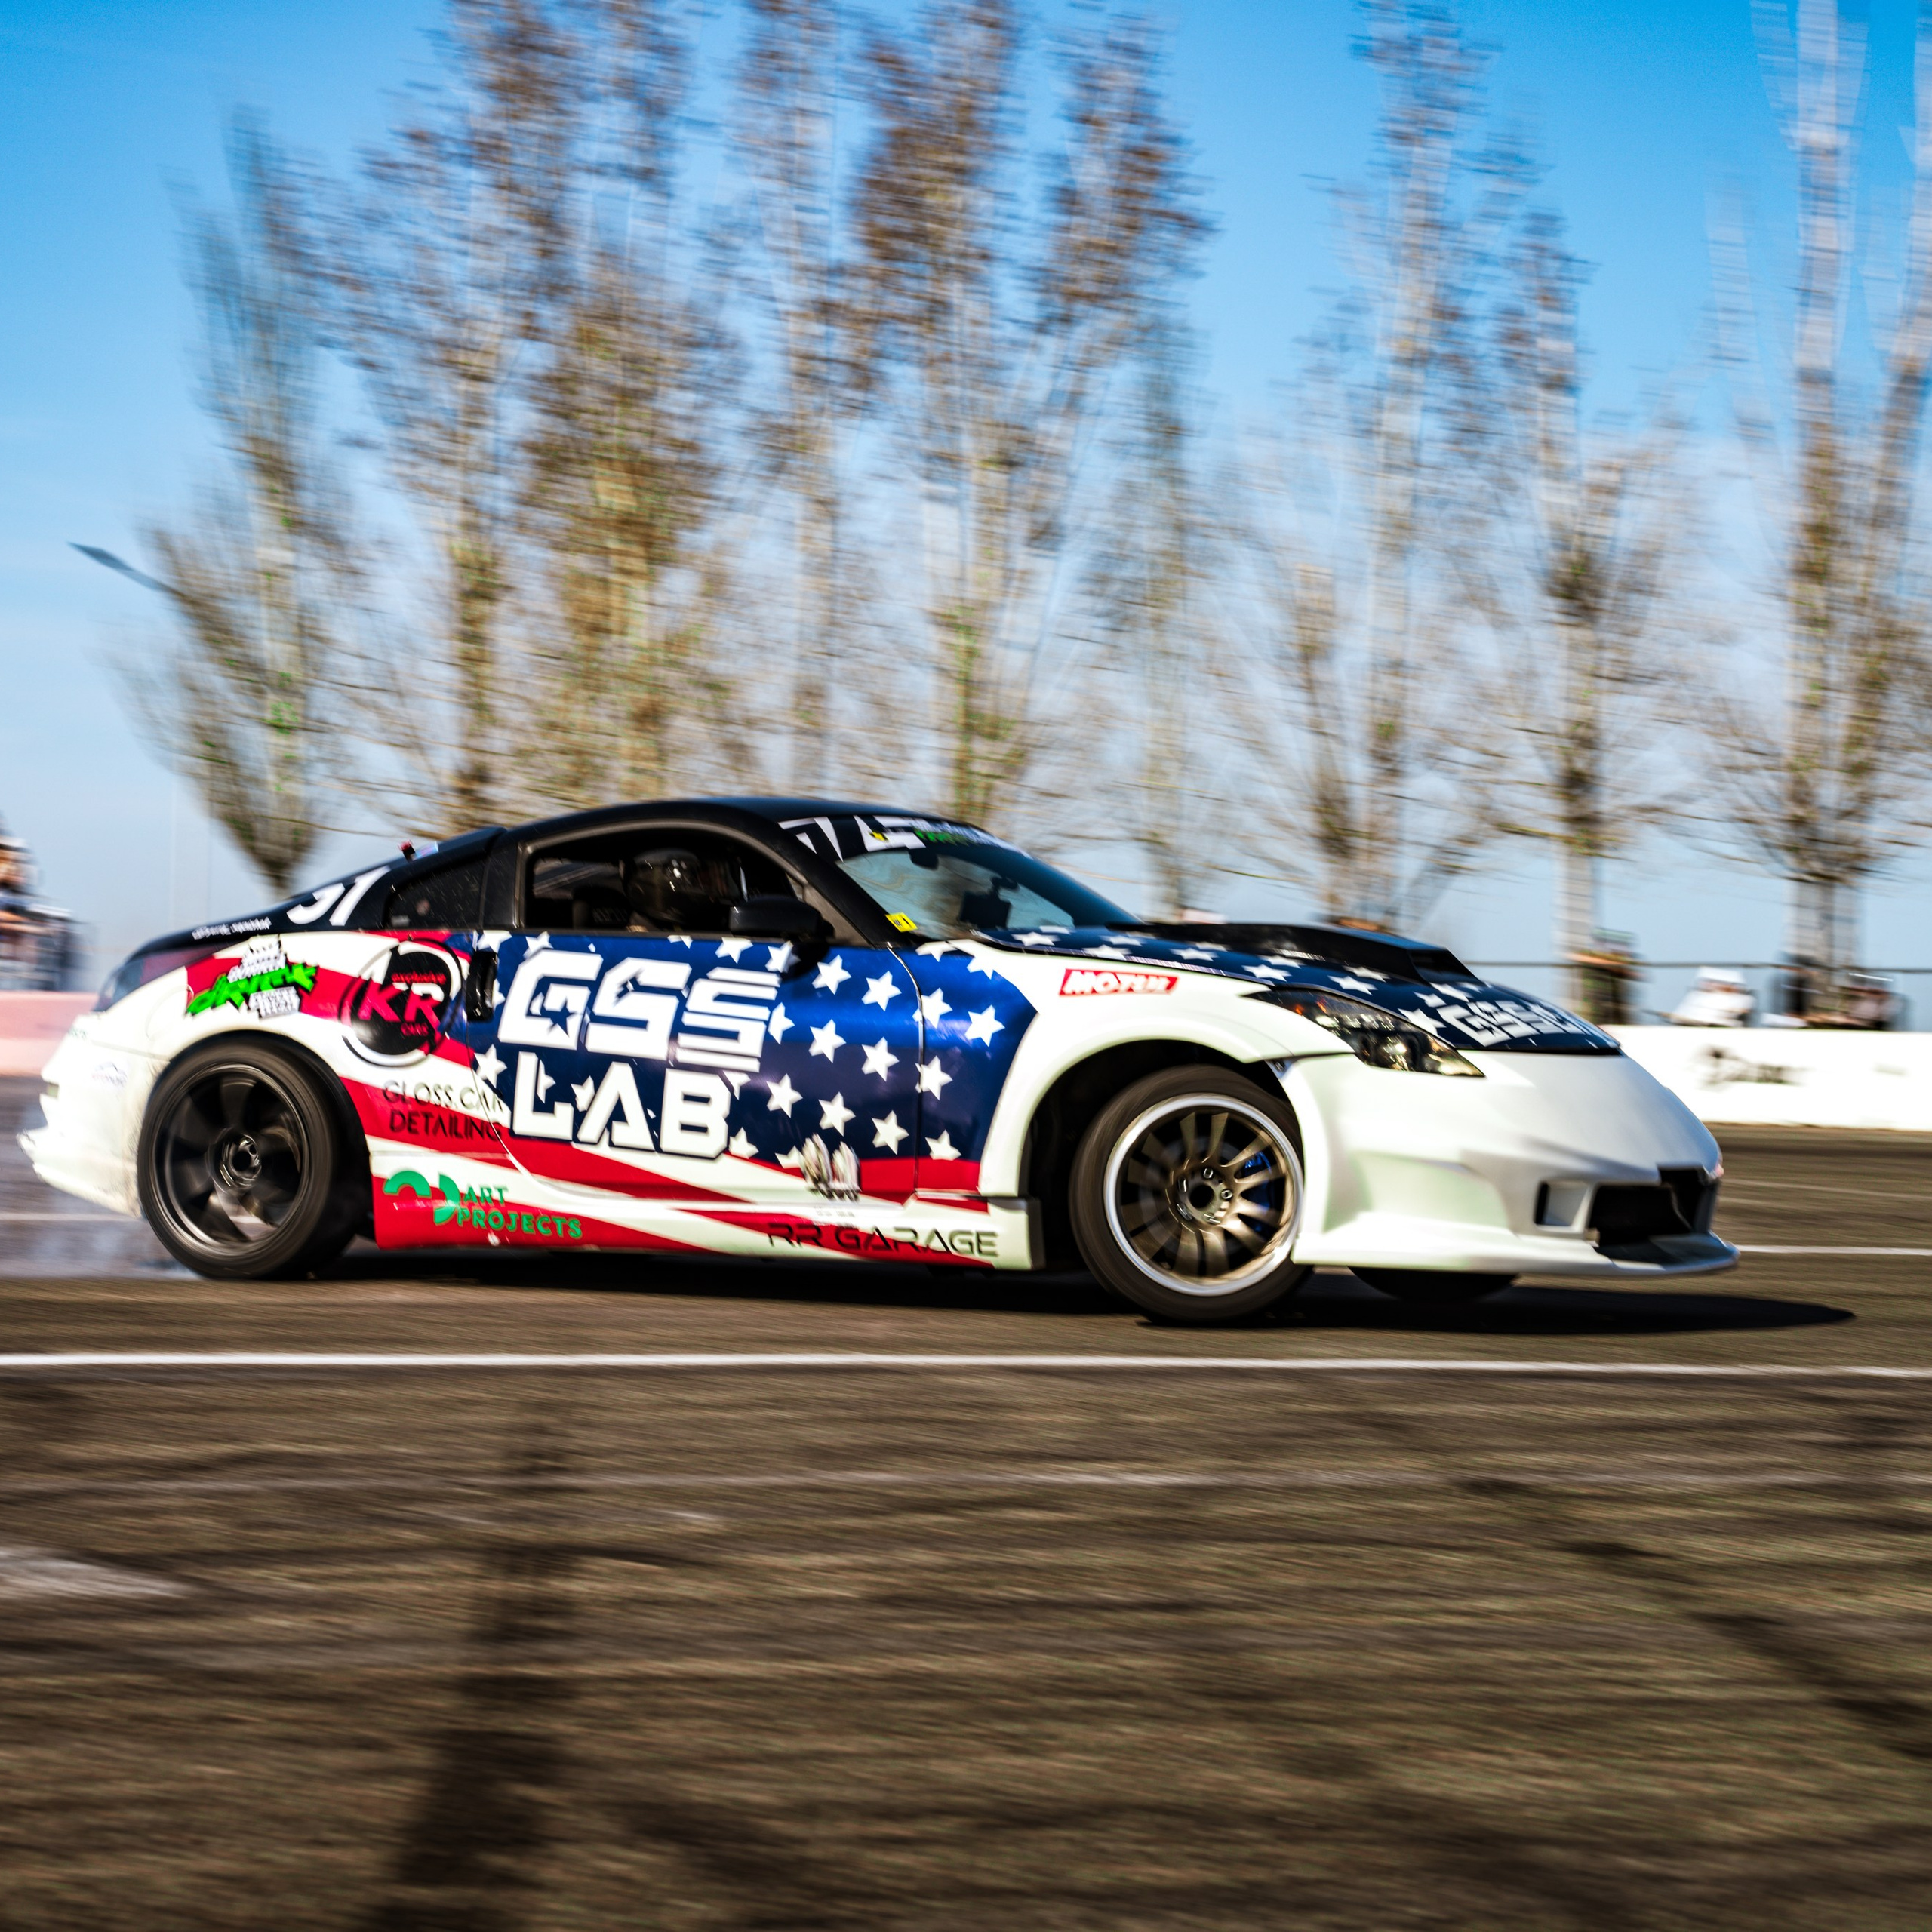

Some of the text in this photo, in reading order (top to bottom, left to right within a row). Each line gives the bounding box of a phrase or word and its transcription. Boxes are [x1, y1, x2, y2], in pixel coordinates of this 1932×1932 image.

[357, 968, 442, 1032] KR
[499, 949, 782, 1072] GSS
[383, 1079, 457, 1108] GLOSS
[512, 1052, 731, 1159] LAB
[389, 1109, 503, 1142] DETAILING
[463, 1185, 508, 1205] ART
[457, 1208, 583, 1239] PROJECTS
[767, 1223, 1000, 1257] RR GARAGE
